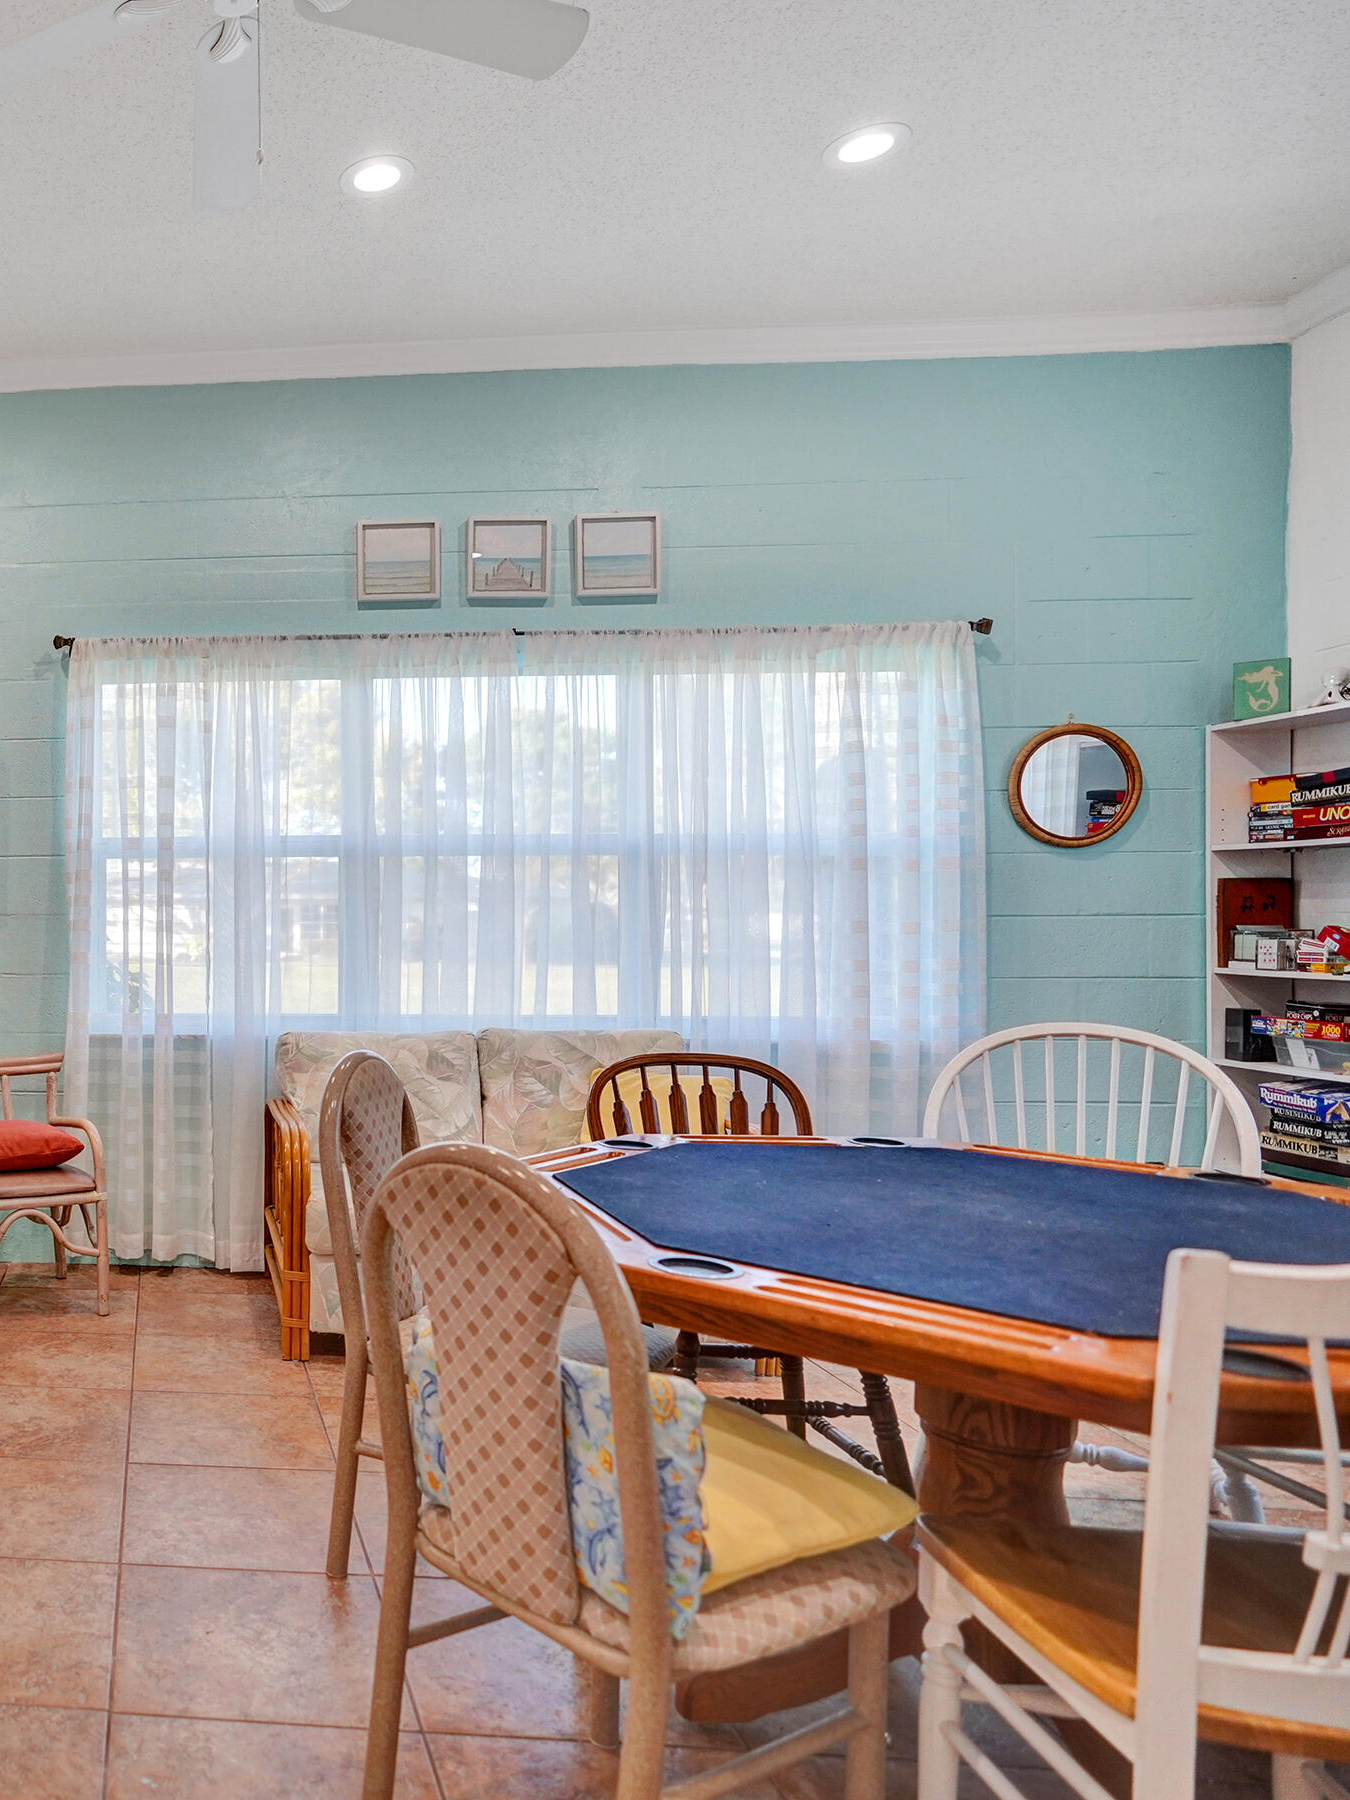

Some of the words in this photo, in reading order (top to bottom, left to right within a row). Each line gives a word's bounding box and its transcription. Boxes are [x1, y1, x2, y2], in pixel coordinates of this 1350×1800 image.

[1319, 806, 1350, 822] UNO
[1321, 1025, 1344, 1036] 1000
[1273, 1121, 1323, 1138] RUMMIKUB
[1261, 1135, 1318, 1155] RUMMIKUB
